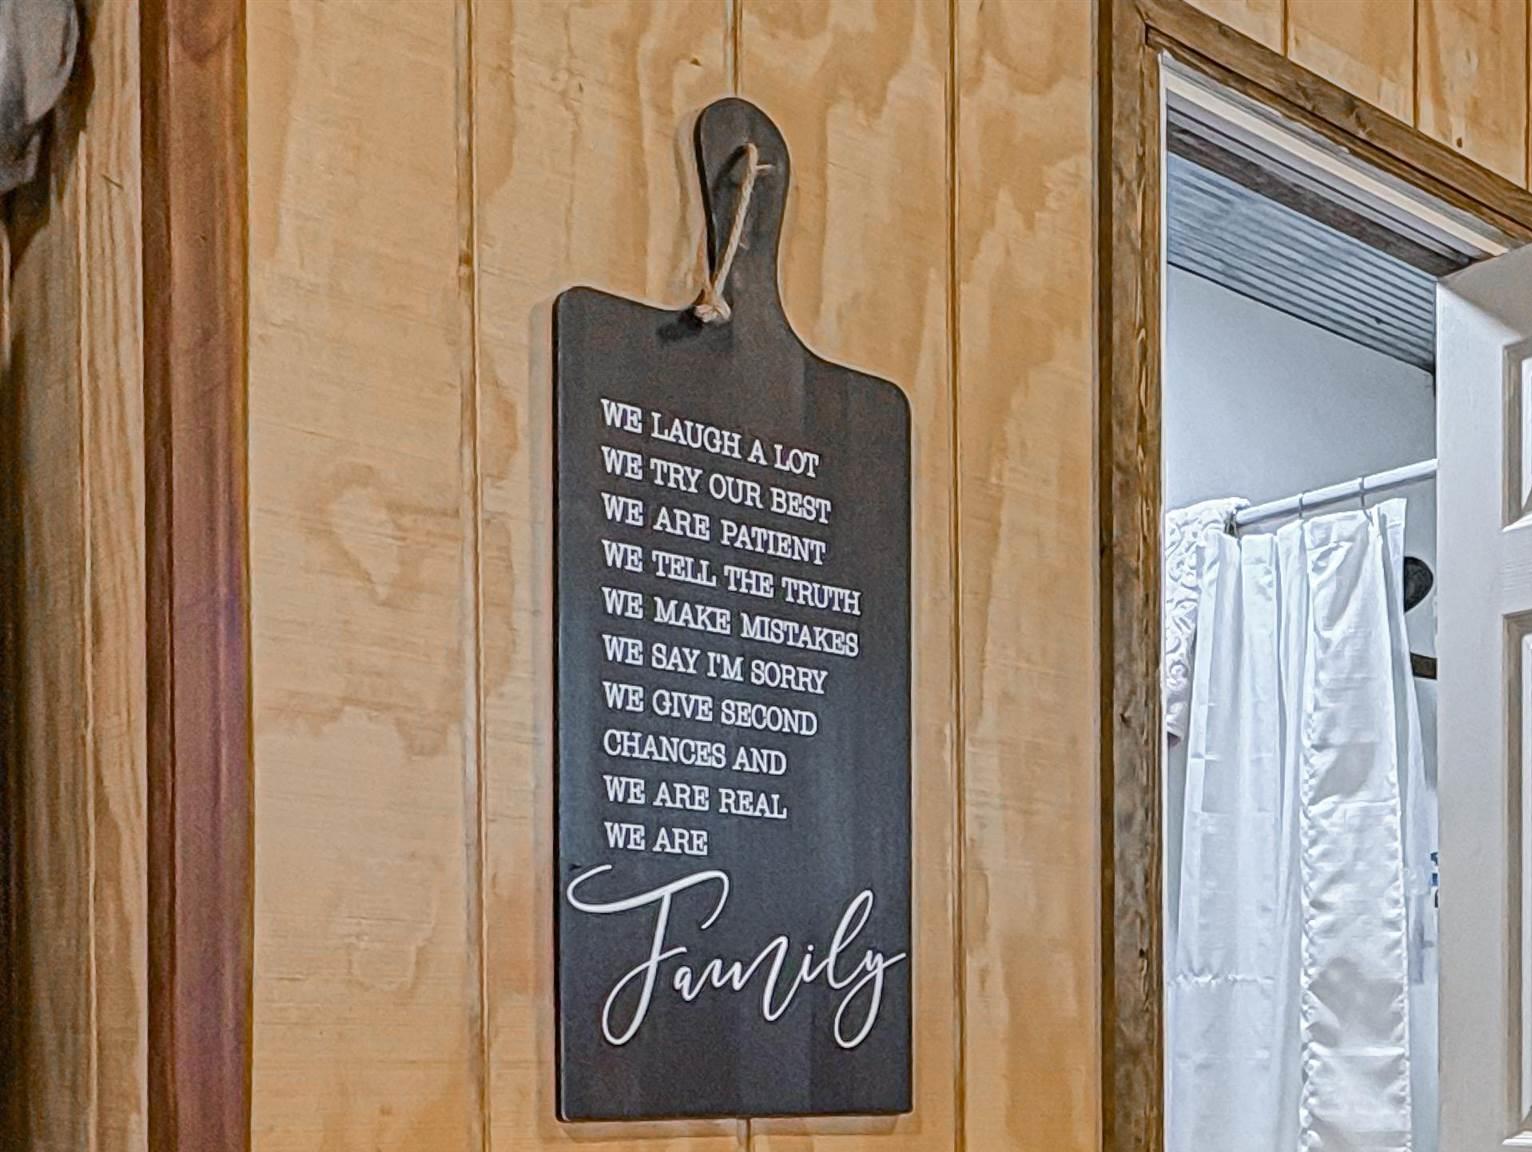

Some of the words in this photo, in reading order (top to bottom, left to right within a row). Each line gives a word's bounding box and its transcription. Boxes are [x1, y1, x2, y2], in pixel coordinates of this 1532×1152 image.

[600, 398, 643, 434] WE
[650, 411, 742, 459] LAUGH
[746, 439, 768, 466] A
[773, 443, 820, 478] LOT
[600, 445, 643, 481] WE
[649, 457, 703, 494] TRY
[708, 473, 764, 509] OUR
[769, 486, 832, 524] BEST
[600, 491, 644, 527] WE
[652, 506, 711, 541] ARE
[720, 519, 826, 566] PATIENT
[601, 538, 643, 573] WE
[651, 549, 717, 587] TELL
[723, 564, 774, 599] THE
[781, 576, 861, 616] TRUTH
[601, 586, 644, 620] WE
[653, 596, 731, 635] MAKE
[740, 612, 859, 657] MISTAKES
[601, 633, 644, 666] WE
[651, 642, 701, 674] SAY
[706, 651, 745, 682] I'M
[750, 659, 829, 695] SORRY
[602, 680, 644, 713] WE
[652, 689, 713, 722] GIVE
[720, 698, 818, 736] SECOND
[603, 728, 727, 769] CHANCES
[731, 746, 787, 776] AND
[602, 774, 646, 805] WE
[652, 781, 710, 812] ARE
[718, 787, 788, 820] REAL
[603, 821, 646, 851] WE
[652, 826, 708, 856] ARE
[566, 864, 907, 1049] Family
